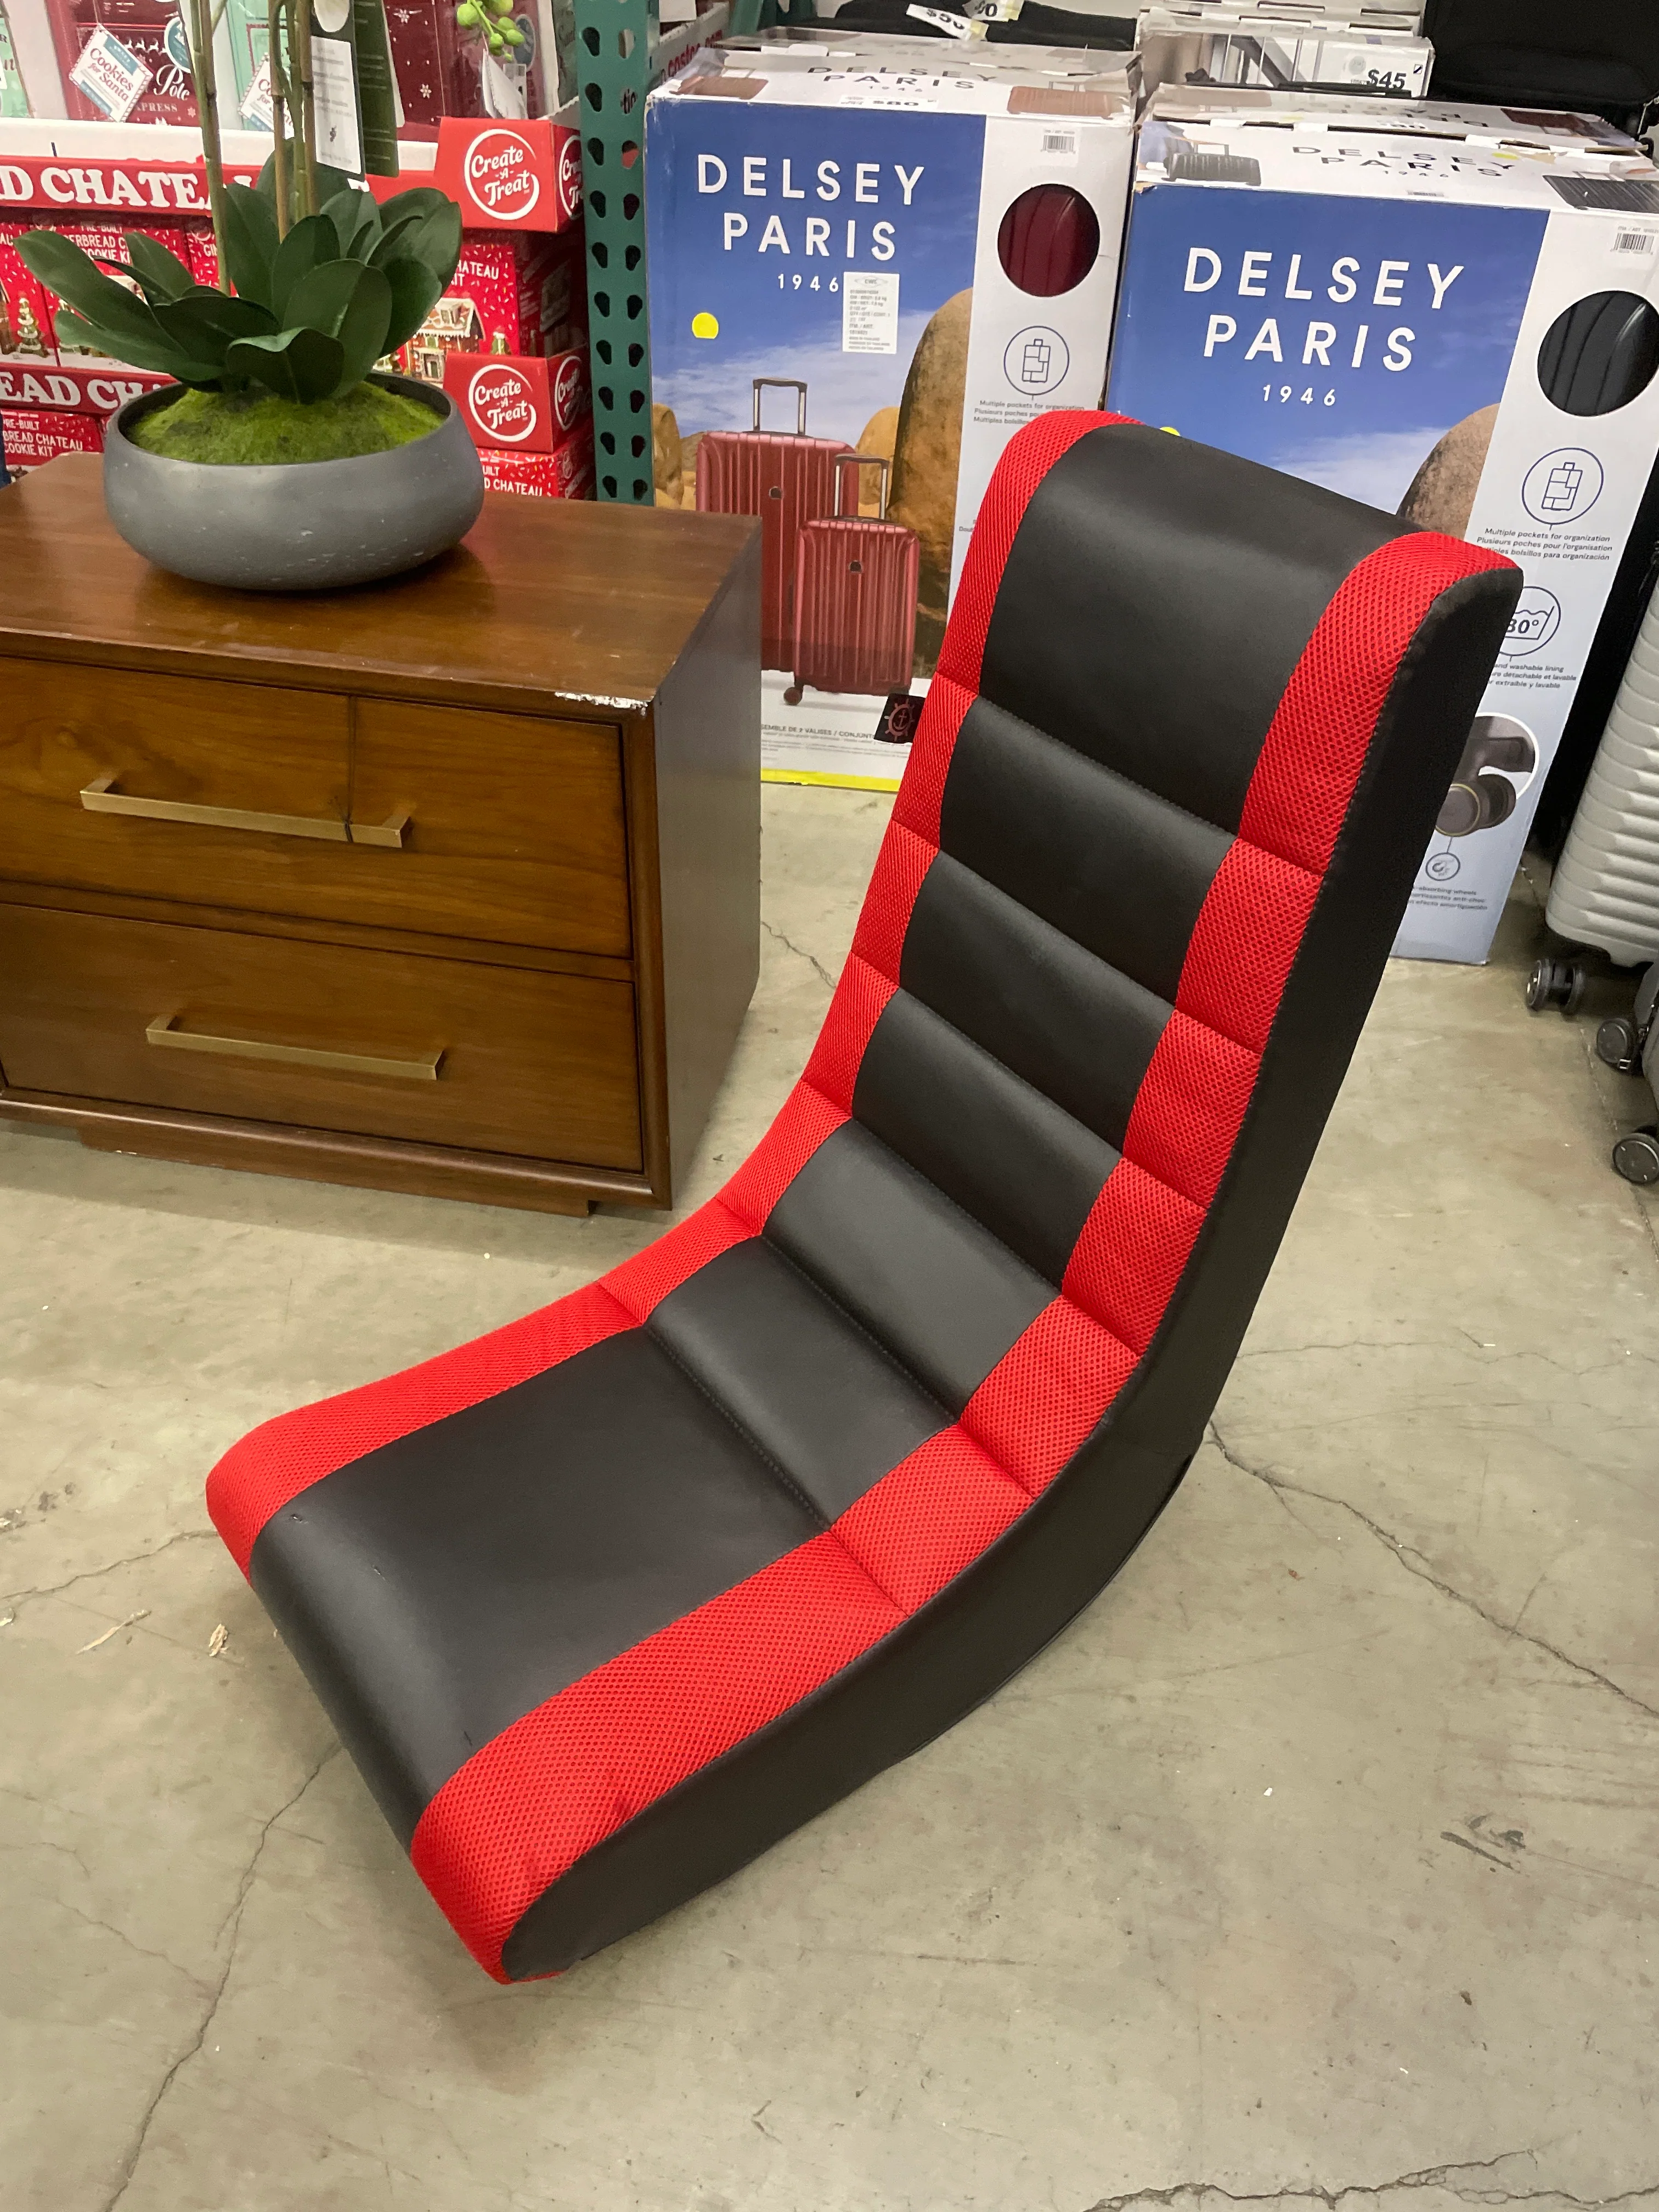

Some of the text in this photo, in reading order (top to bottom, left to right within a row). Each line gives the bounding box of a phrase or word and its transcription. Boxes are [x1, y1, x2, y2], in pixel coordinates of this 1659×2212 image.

[90, 48, 134, 92] Cookies
[807, 66, 997, 81] DELSEY
[1368, 68, 1407, 89] $45
[88, 63, 101, 74] for
[99, 72, 130, 102] Santa
[153, 64, 190, 101] Pole
[823, 75, 974, 89] PARIS
[471, 145, 523, 178] Create
[1292, 146, 1515, 170] DELSEY
[1321, 157, 1503, 177] PARIS
[40, 167, 213, 210] CHATE
[484, 170, 530, 206] Treat
[698, 154, 924, 205] DELSEY
[67, 234, 114, 248] ERBREAD
[724, 212, 895, 261] PARIS
[777, 273, 839, 293] 1946
[1183, 247, 1465, 309] DELSEY
[1203, 314, 1416, 372] PARIS
[475, 379, 522, 405] Create
[1262, 384, 1336, 407] 1946
[487, 400, 528, 430] Treat
[36, 433, 83, 451] CHATEAU
[38, 445, 53, 456] KIT
[493, 479, 543, 497] CHATEAU
[1476, 537, 1511, 545] Plusieurs
[1513, 540, 1541, 549] poches
[1562, 543, 1613, 552] l'organisation
[1485, 527, 1516, 538] Multiple
[1517, 531, 1549, 540] pockets
[1564, 534, 1610, 543] organization
[1511, 549, 1542, 557] bolsillos
